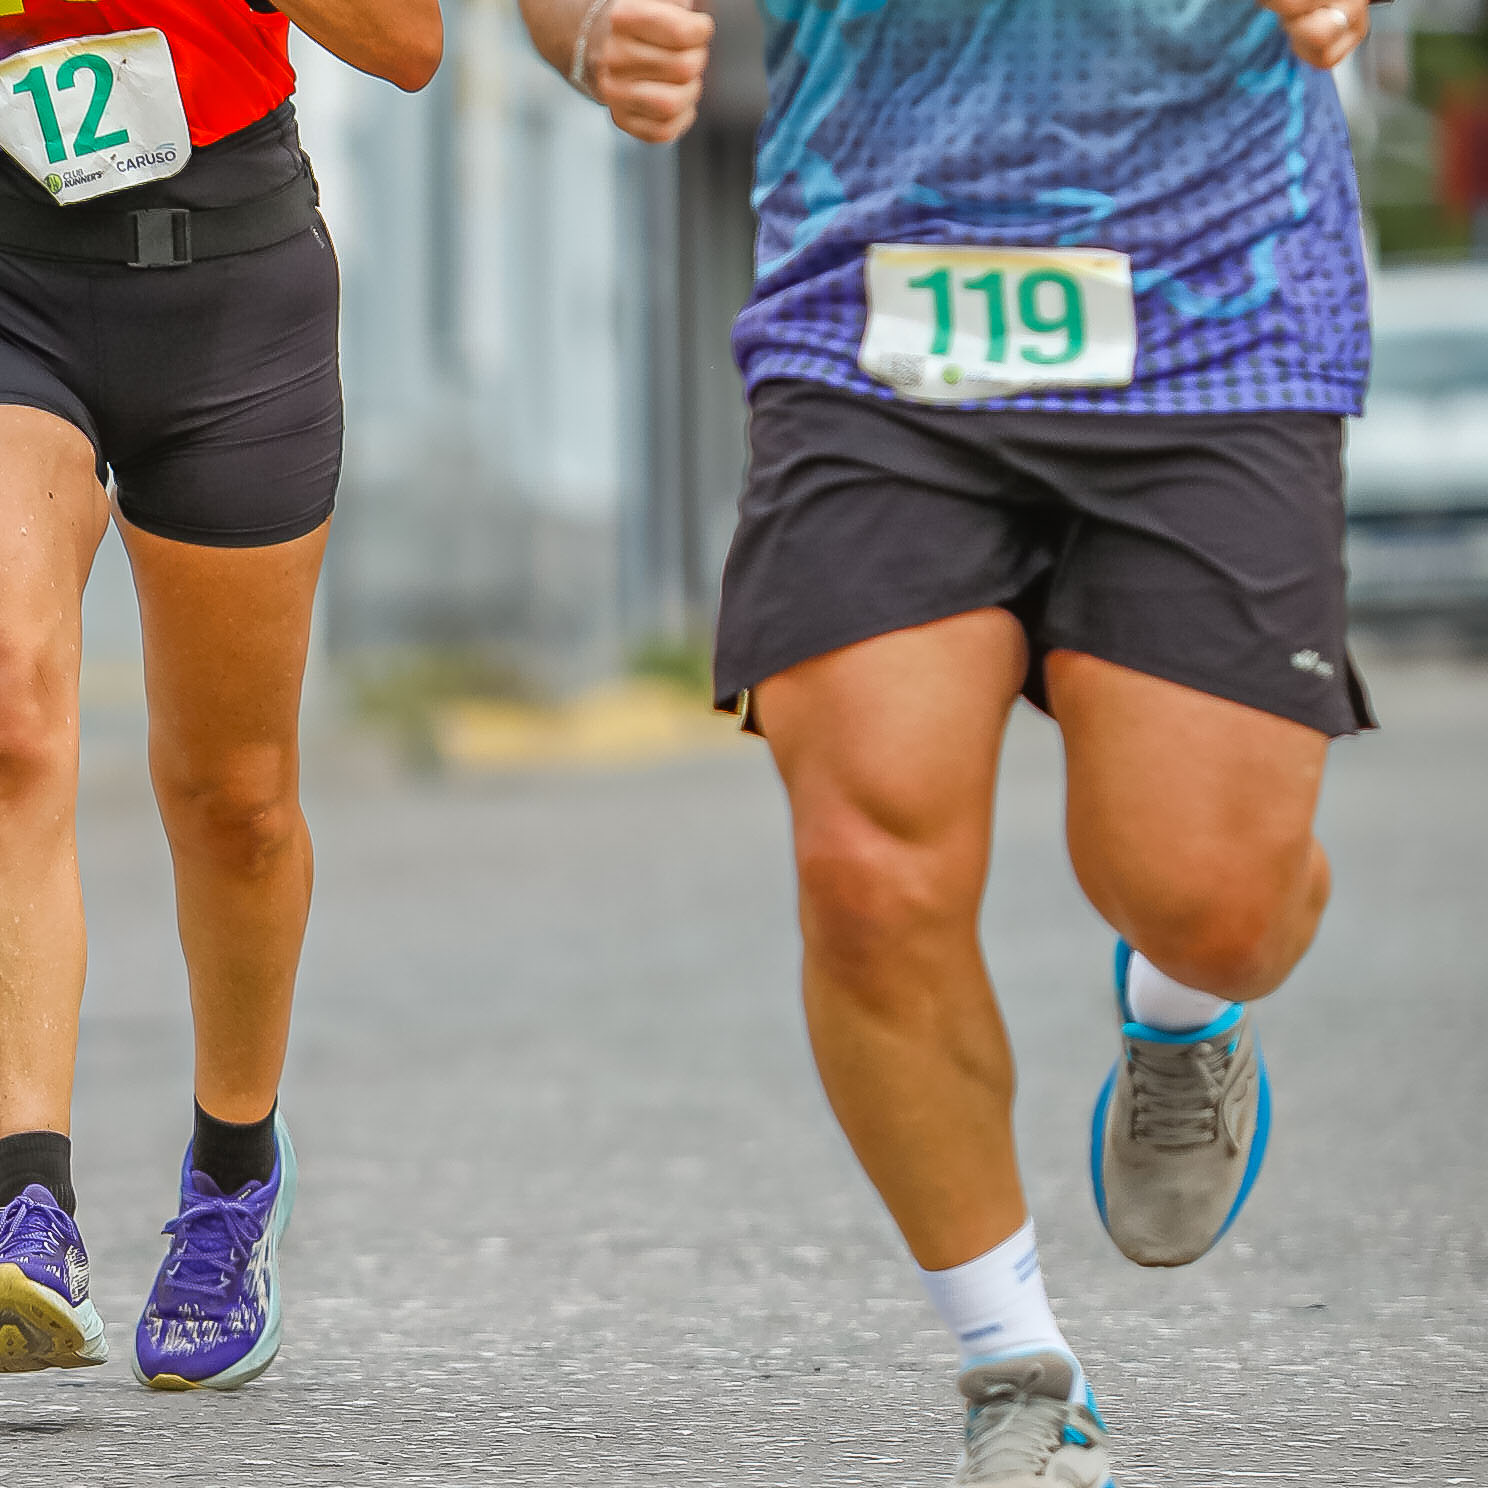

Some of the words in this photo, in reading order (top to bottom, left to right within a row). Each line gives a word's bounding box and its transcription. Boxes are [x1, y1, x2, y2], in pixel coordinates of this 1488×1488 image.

[13, 53, 129, 164] 12
[116, 150, 177, 173] CARUSO
[908, 267, 1086, 365] 119
